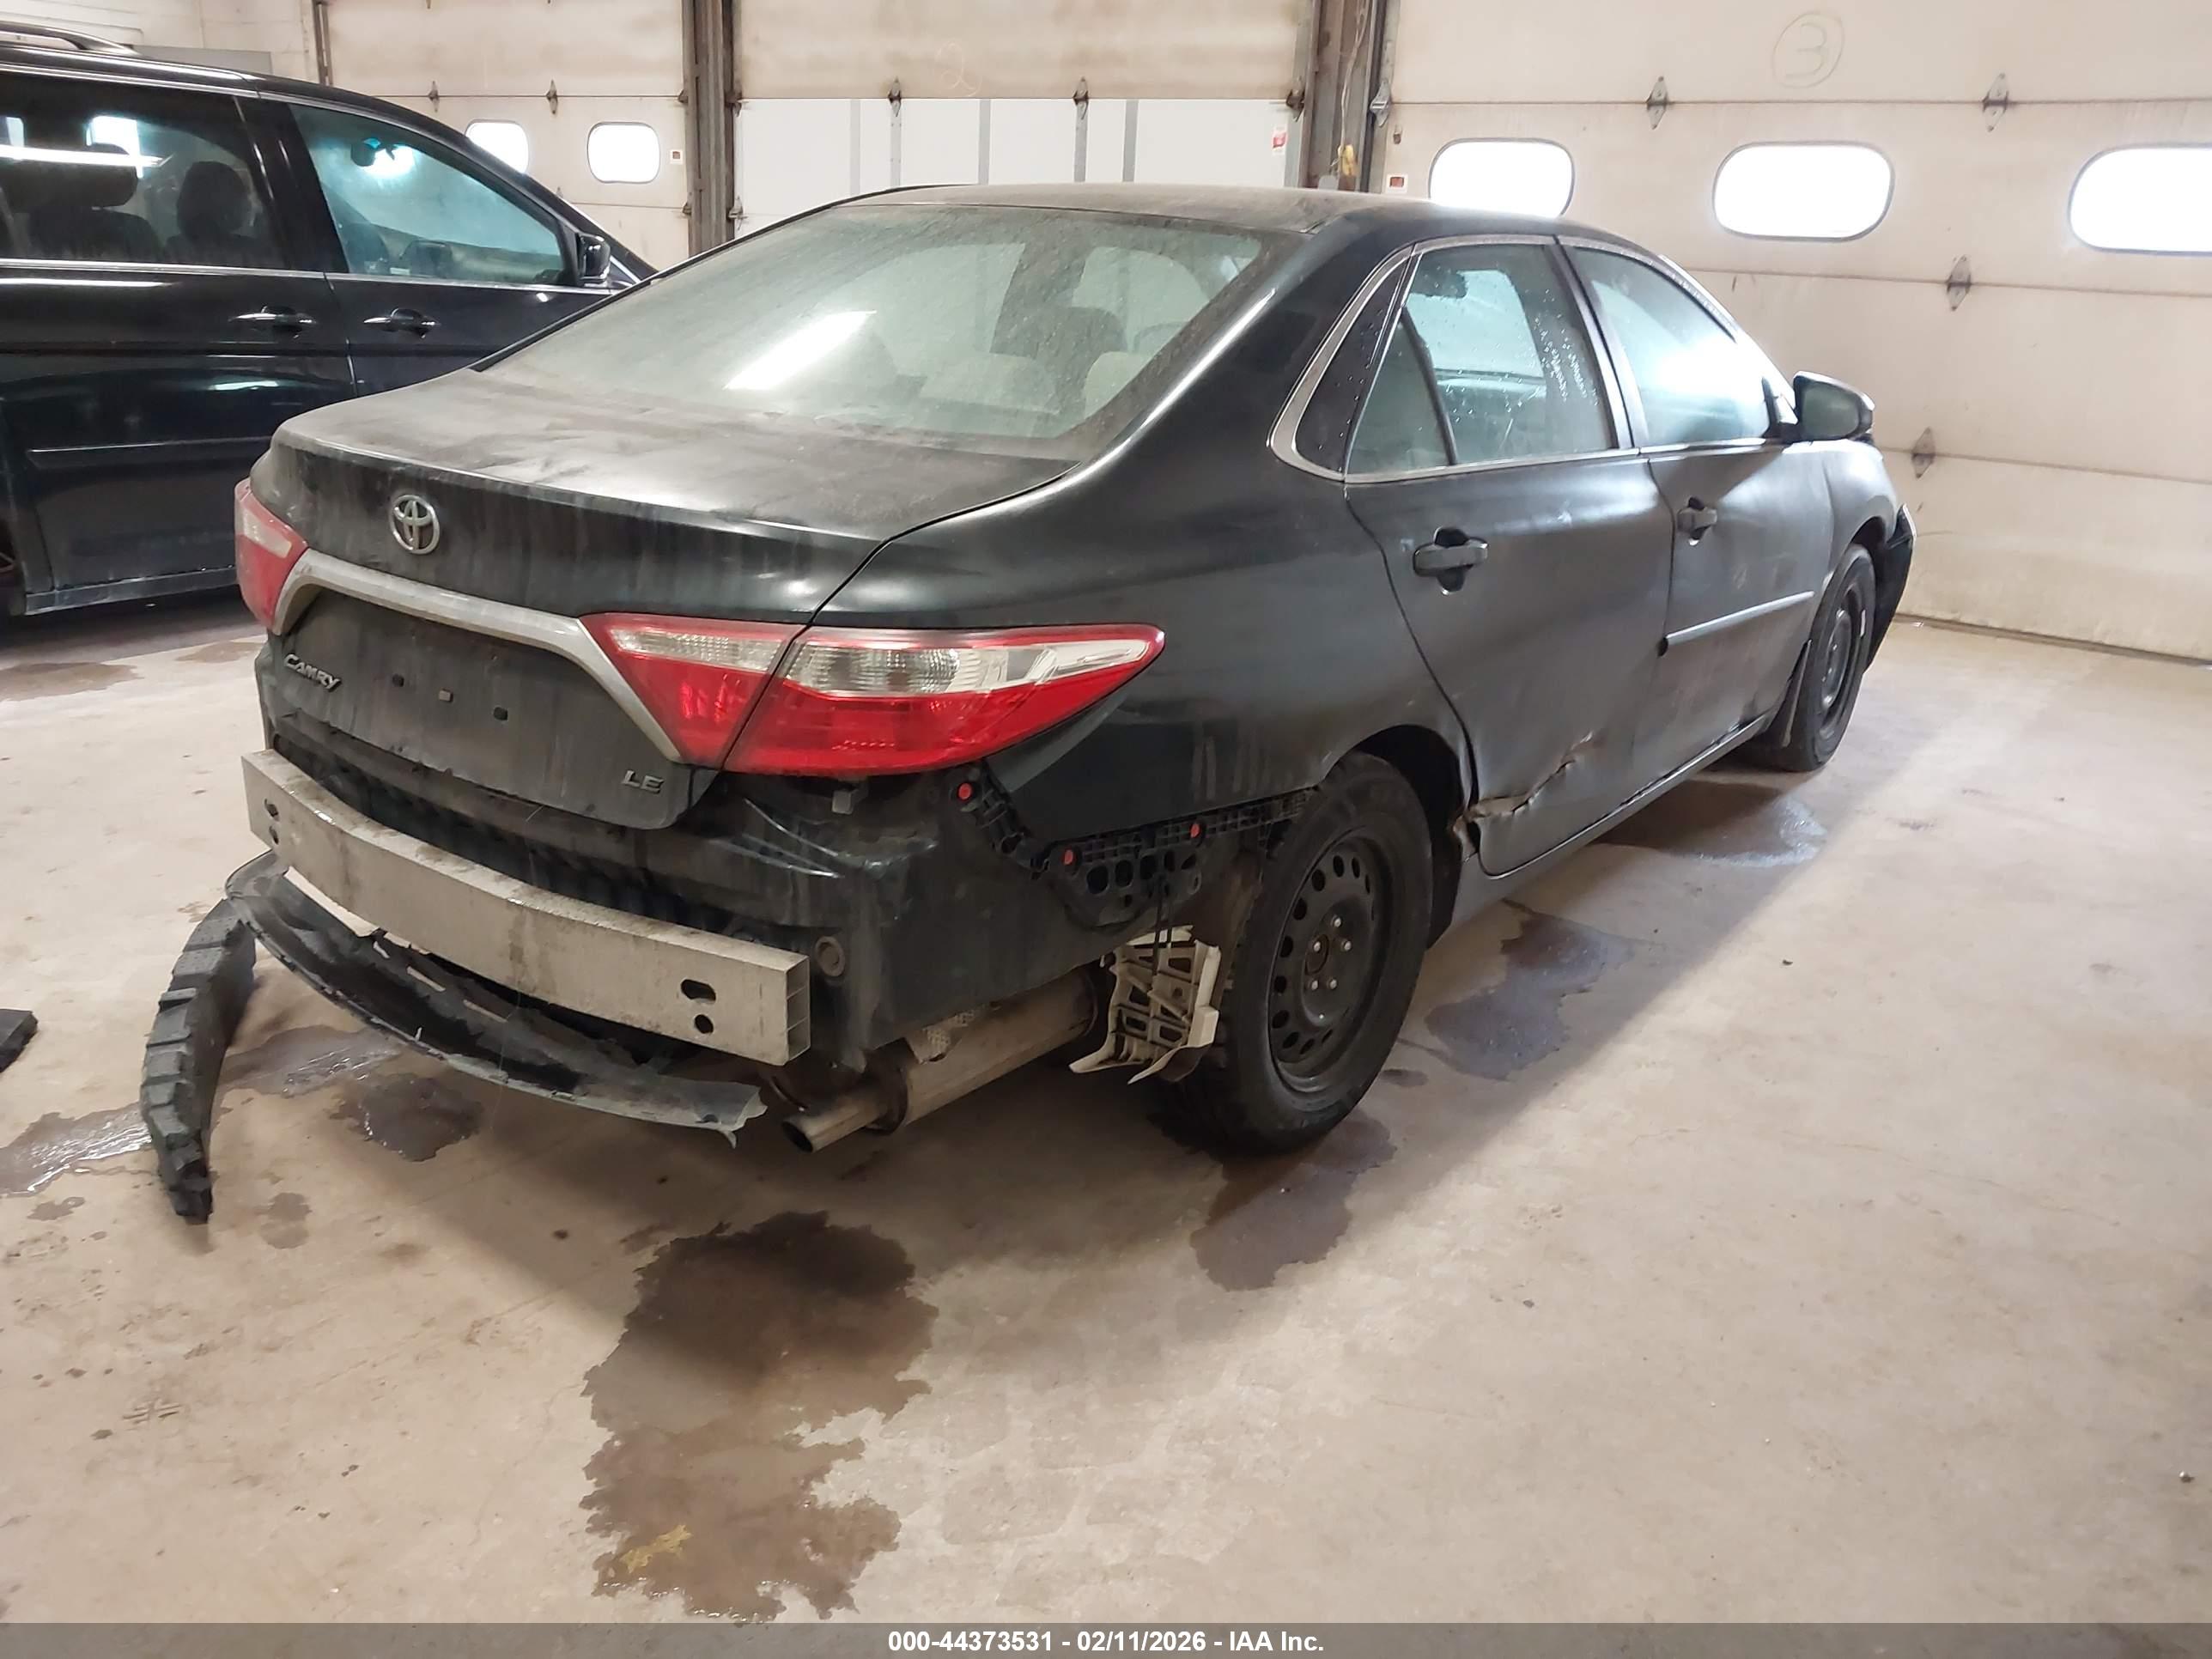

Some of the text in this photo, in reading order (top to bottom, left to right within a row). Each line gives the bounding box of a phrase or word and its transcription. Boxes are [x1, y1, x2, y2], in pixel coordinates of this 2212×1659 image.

[1785, 21, 1828, 78] 3
[284, 653, 342, 690] CAMRY
[622, 769, 665, 793] LE
